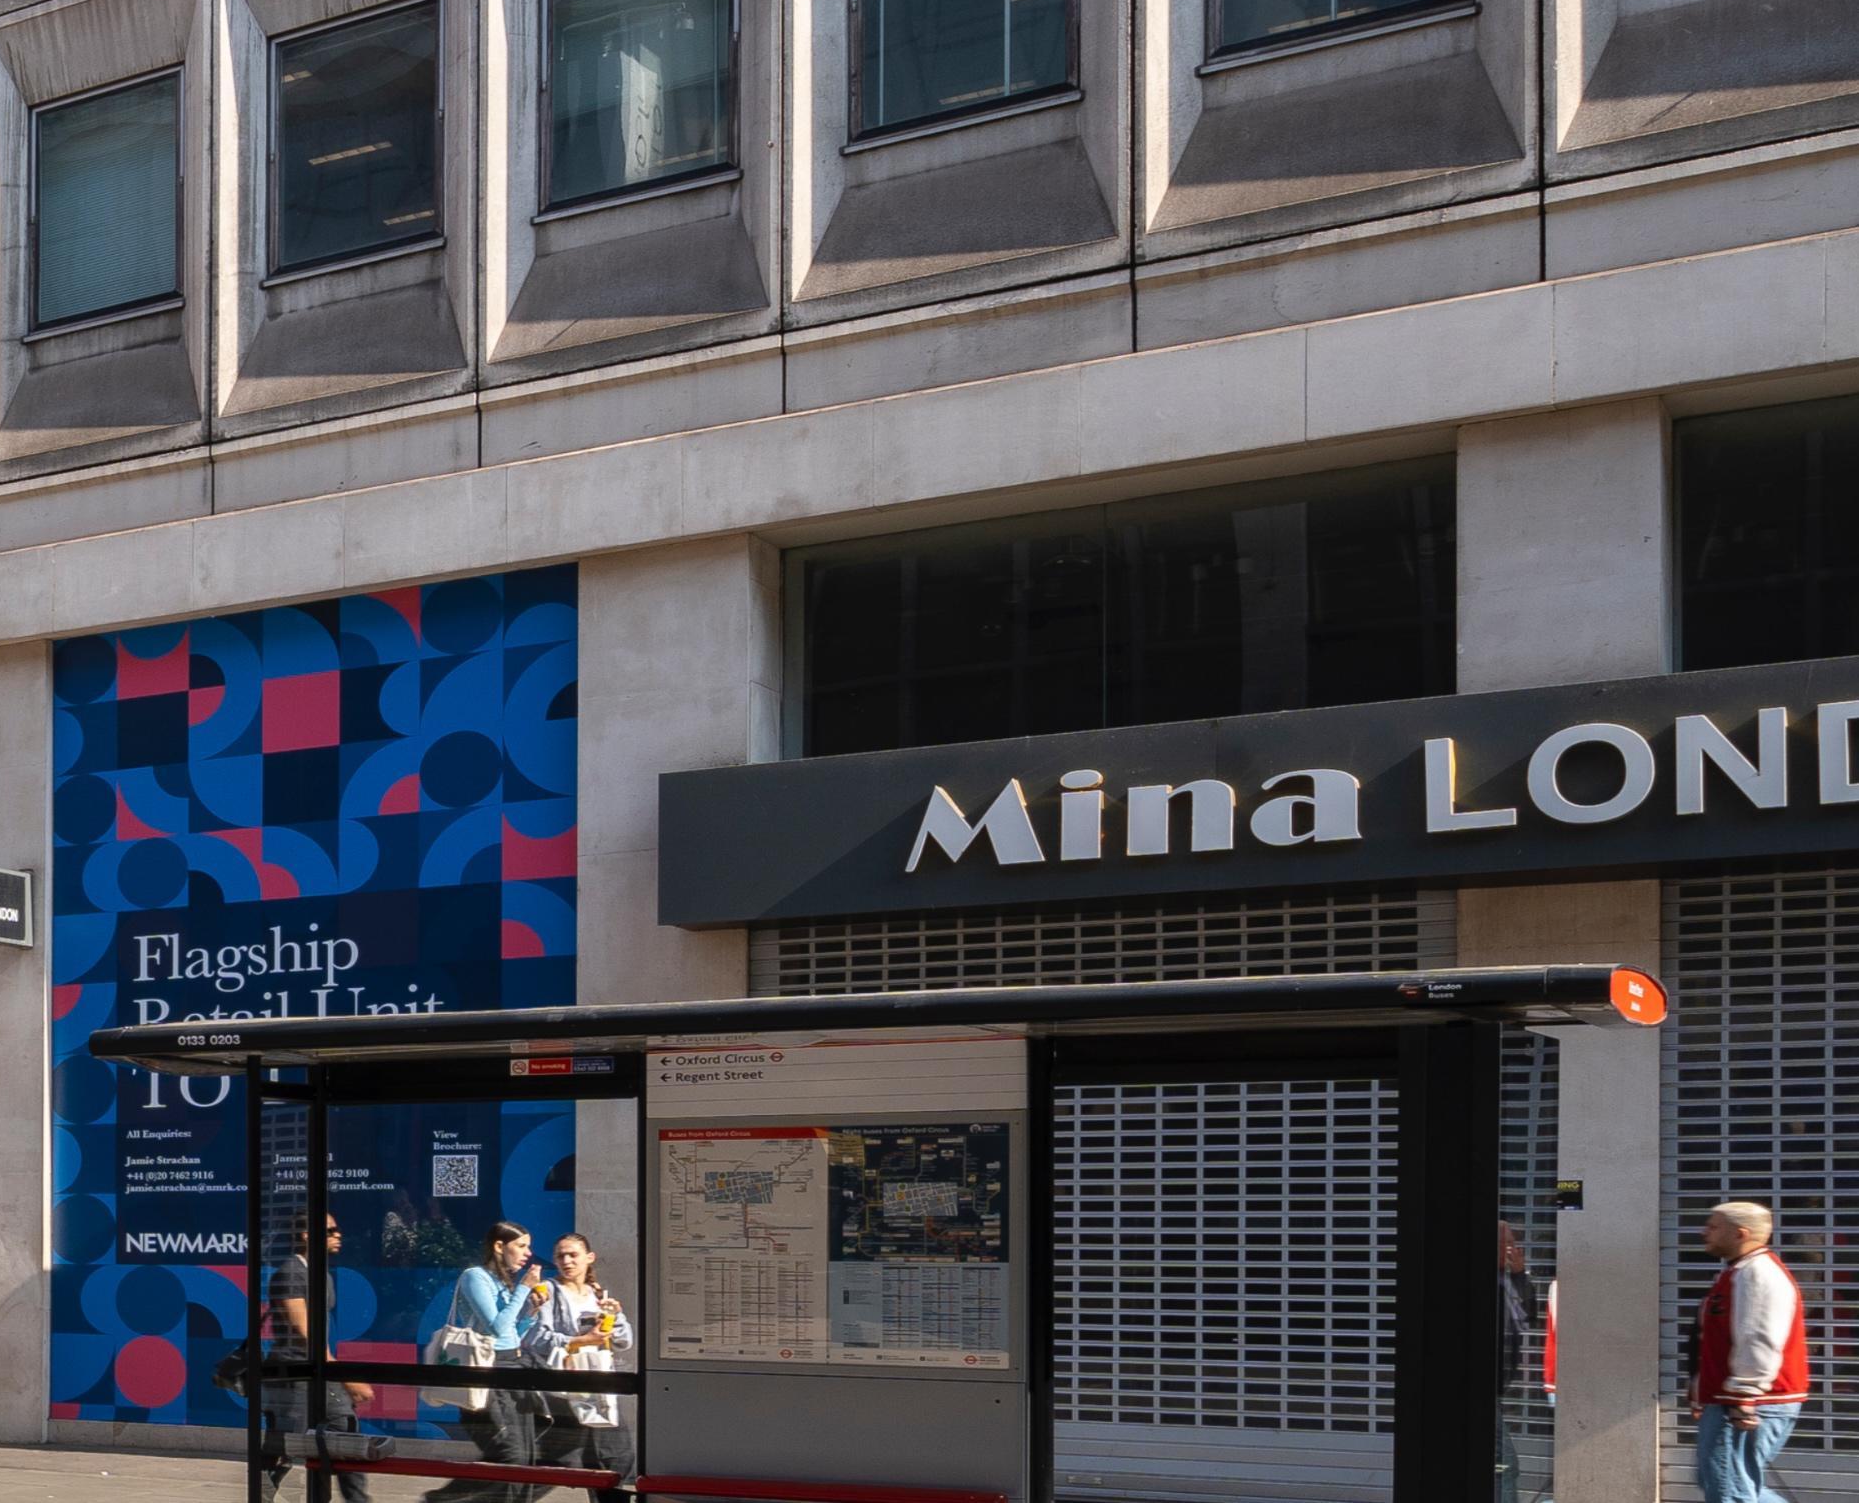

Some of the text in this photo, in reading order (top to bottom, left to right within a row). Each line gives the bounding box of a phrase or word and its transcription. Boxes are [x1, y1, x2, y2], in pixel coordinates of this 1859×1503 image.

[905, 767, 1362, 874] Mina
[132, 923, 359, 993] Flagship
[1427, 983, 1462, 991] London
[133, 991, 289, 1025] Rtil
[177, 1034, 241, 1046] 0133 0203
[675, 1053, 766, 1066] Oxford Circus
[675, 1070, 764, 1083] Regent Street
[126, 1129, 192, 1141] All Enquiries:
[433, 1130, 459, 1139] View
[705, 1130, 729, 1138] Oxford
[433, 1142, 482, 1151] Brochure:
[124, 1155, 201, 1167] Jamie Strachan
[273, 1154, 308, 1165] James
[126, 1172, 144, 1181] +44
[169, 1171, 190, 1180] 7462
[192, 1170, 214, 1180] 9116
[327, 1169, 344, 1179] 462
[345, 1169, 370, 1178] 9100
[125, 1183, 249, 1194] jamie.strachan@nmrk.co
[125, 1232, 249, 1253] NEWMARK
